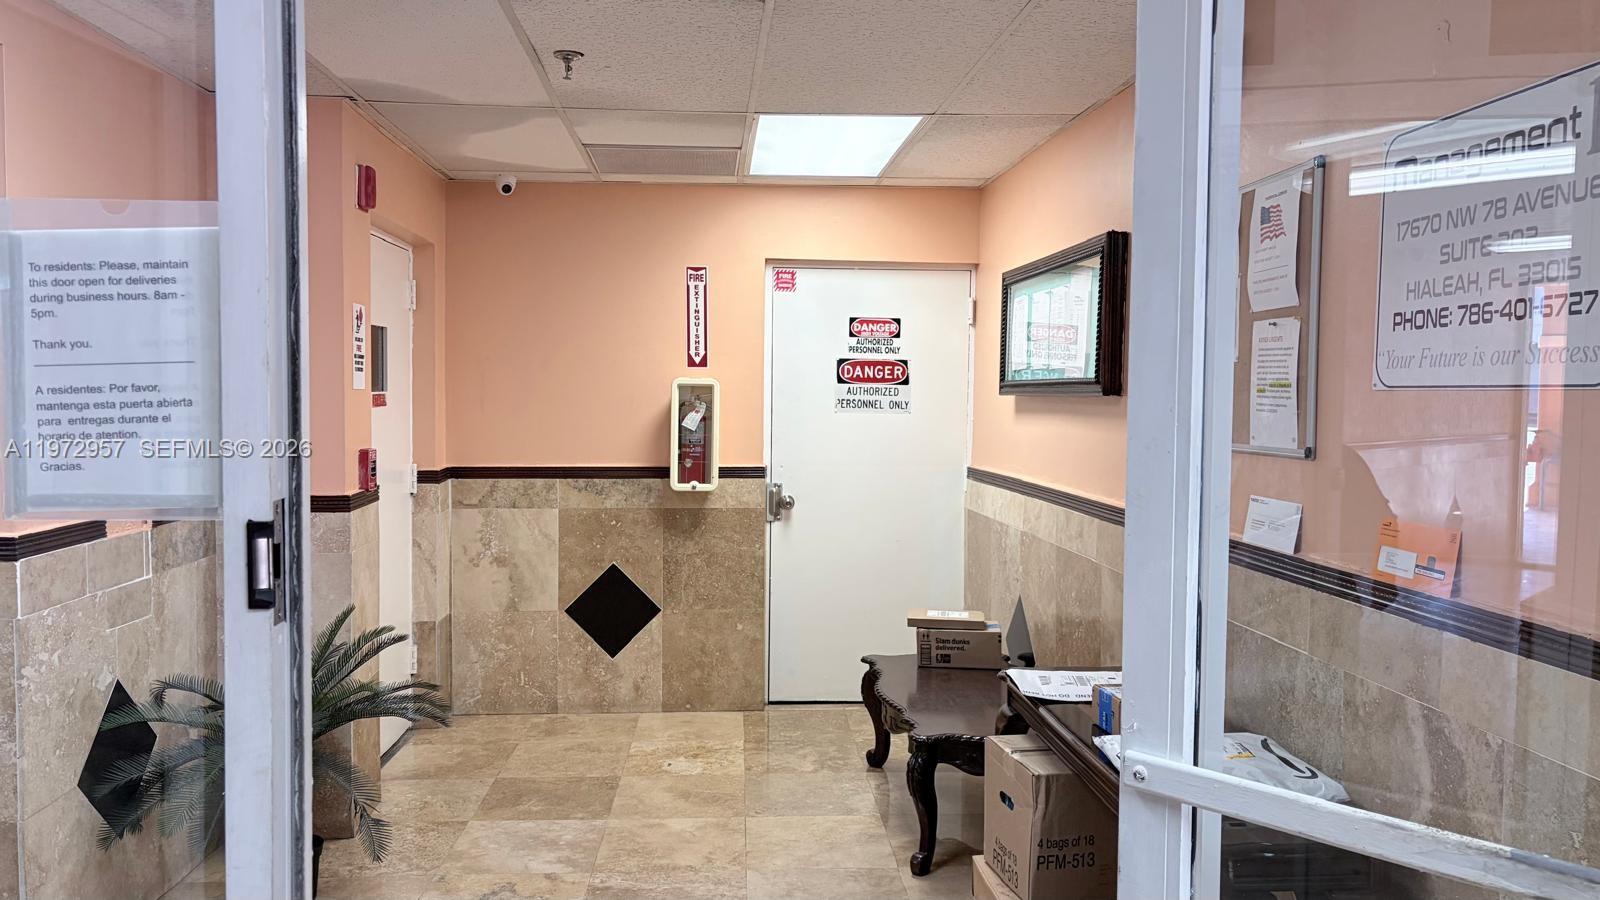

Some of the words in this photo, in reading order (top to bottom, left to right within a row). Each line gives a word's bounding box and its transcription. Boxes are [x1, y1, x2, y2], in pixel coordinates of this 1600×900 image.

[1397, 213, 1442, 242] 17670
[1446, 203, 1478, 230] NW
[1482, 197, 1507, 223] 78
[1512, 174, 1600, 216] AVENUE
[1439, 234, 1493, 265] SUITE
[28, 262, 41, 272] To
[44, 261, 96, 272] residents:
[99, 260, 140, 272] Please,
[143, 259, 189, 270] maintain
[28, 278, 48, 288] this
[51, 277, 75, 287] door
[78, 278, 105, 289] open
[108, 276, 122, 286] for
[125, 275, 177, 286] deliveries
[688, 273, 705, 283] FIRE
[1406, 271, 1483, 301] HIALEAH,
[1487, 267, 1513, 290] FL
[1518, 256, 1582, 287] 33015
[29, 293, 64, 304] during
[66, 291, 114, 302] business
[117, 290, 150, 301] hours.
[153, 290, 178, 300] 8am
[30, 308, 58, 320] 5pm.
[1393, 307, 1452, 332] PHONE:
[1457, 290, 1599, 326] 786-401-5727
[693, 284, 701, 358] EXTINGUISHER
[853, 323, 897, 332] DANGER
[32, 339, 67, 350] Thank
[70, 340, 92, 352] you.
[856, 338, 894, 346] AUTHORIZED
[848, 345, 883, 354] PERSONNEL
[884, 346, 901, 355] ONLY
[1418, 347, 1467, 369] Future
[1472, 346, 1486, 367] is
[1490, 349, 1521, 366] our
[1525, 341, 1600, 365] Success
[844, 365, 904, 379] DANGER
[35, 385, 43, 395] A
[46, 385, 106, 395] residentes:
[109, 384, 128, 394] Por
[131, 383, 161, 394] favor,
[846, 386, 900, 397] AUTHORIZED
[36, 402, 90, 412] mantenga
[93, 400, 116, 410] esta
[119, 399, 153, 411] puerta
[156, 398, 193, 408] abierta
[836, 398, 885, 410] PERSONNEL
[888, 400, 910, 410] ONLY
[37, 418, 62, 428] para
[67, 416, 115, 426] entregas
[118, 414, 159, 424] durante
[162, 413, 172, 423] el
[38, 431, 75, 442] horario
[78, 430, 92, 441] de
[95, 429, 141, 440] atention.
[39, 461, 85, 472] Gracias.
[935, 644, 967, 652] delivered.
[951, 637, 971, 646] dunks
[1037, 838, 1044, 849] 4
[1046, 837, 1070, 851] bags
[1071, 835, 1081, 847] of
[1083, 834, 1096, 847] 18
[1037, 852, 1096, 871] PFM-513
